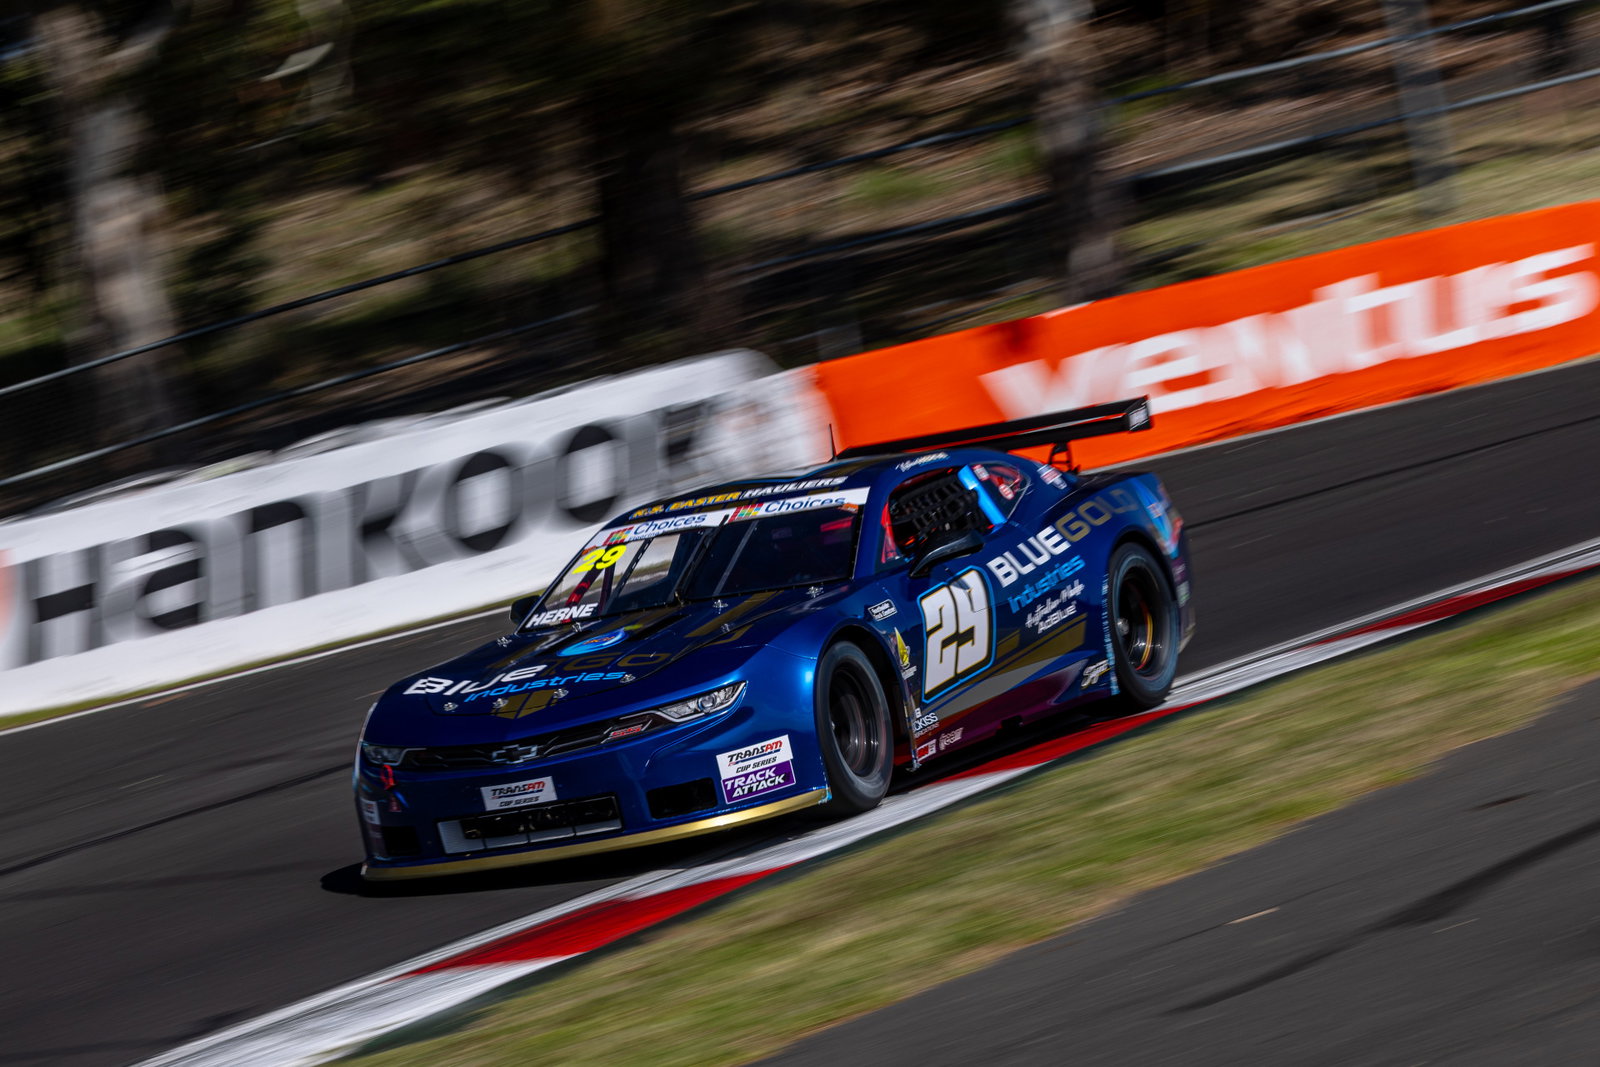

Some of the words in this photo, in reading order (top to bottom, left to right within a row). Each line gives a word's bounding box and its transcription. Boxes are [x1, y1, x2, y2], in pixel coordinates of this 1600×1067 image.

[665, 490, 741, 513] EASTER
[740, 475, 849, 500] HAULIERS
[764, 496, 846, 513] Choices
[633, 513, 708, 535] Choices
[571, 544, 627, 575] 29
[525, 602, 599, 628] HERNE
[924, 569, 988, 695] 29
[752, 756, 777, 769] SERIES
[725, 766, 776, 790] TRACK
[732, 773, 785, 798] ATTACK
